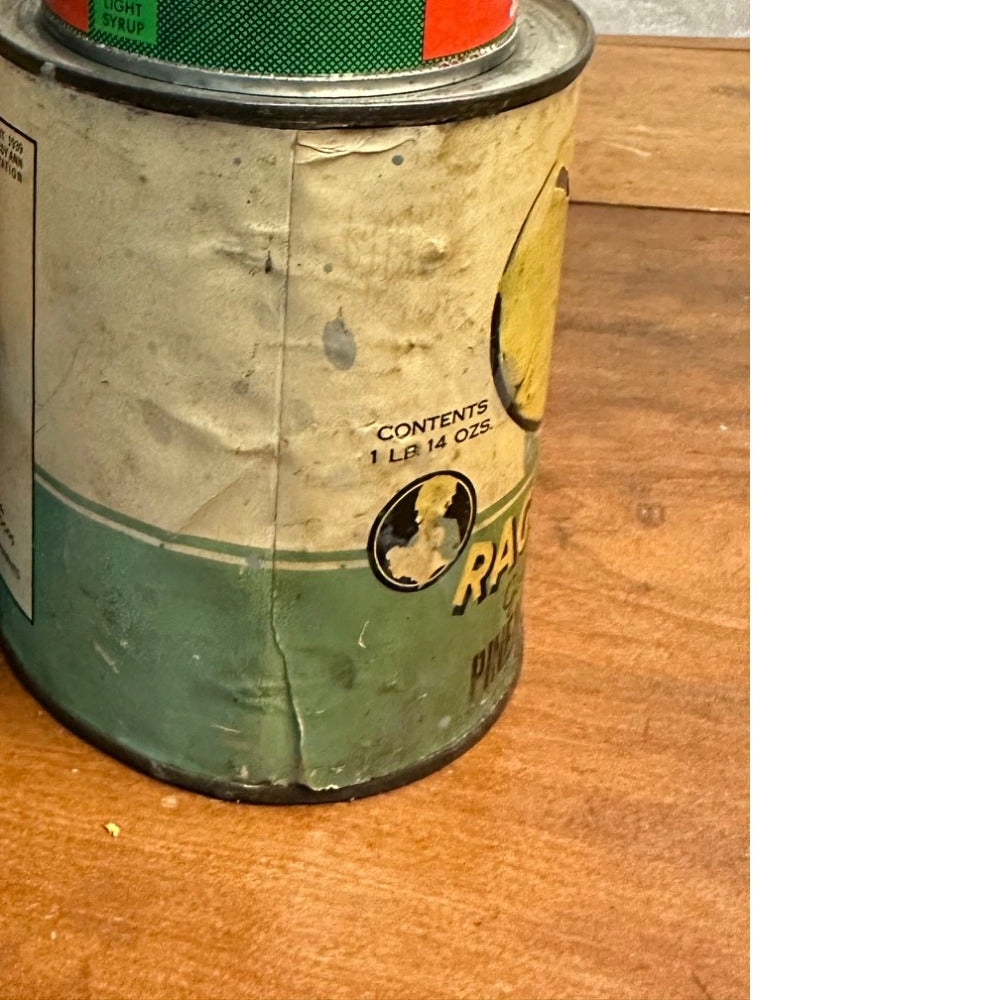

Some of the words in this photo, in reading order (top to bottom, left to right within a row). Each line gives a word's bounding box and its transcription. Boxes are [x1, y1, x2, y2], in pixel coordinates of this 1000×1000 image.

[102, 13, 145, 35] SYRUP
[104, 0, 142, 17] LIGHT
[376, 399, 488, 441] CONTENTS
[370, 449, 378, 464] 1
[427, 435, 447, 454] 14
[455, 418, 494, 444] OZS.
